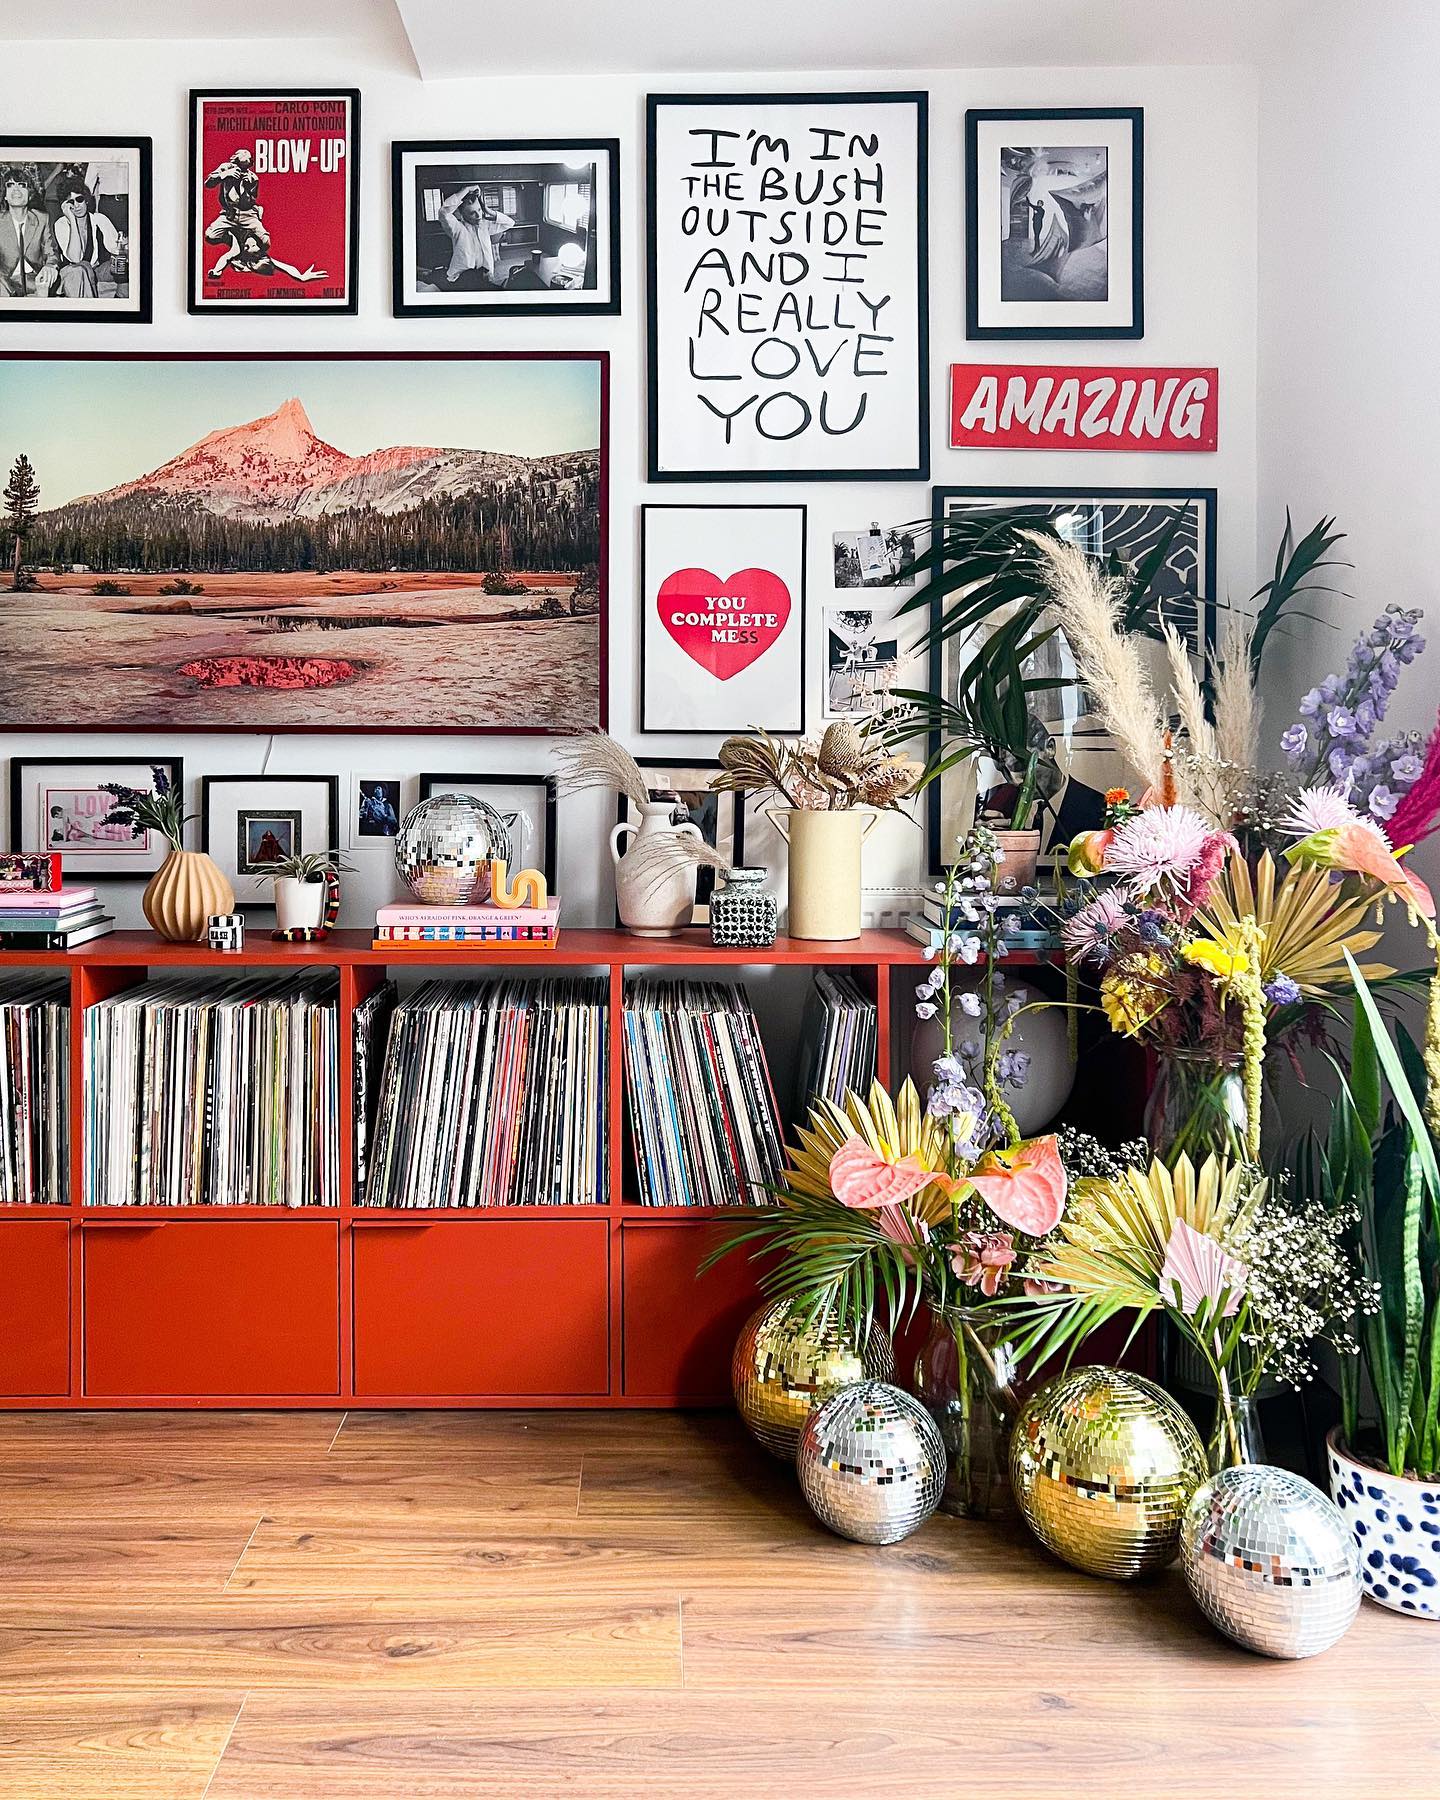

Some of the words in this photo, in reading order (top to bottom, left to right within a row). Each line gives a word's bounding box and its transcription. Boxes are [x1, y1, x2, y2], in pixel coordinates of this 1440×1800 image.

[217, 117, 289, 131] MICHELANGELO
[292, 116, 346, 131] ANTONIONI
[275, 102, 309, 113] CARLO
[313, 102, 346, 113] PONTI
[255, 138, 346, 173] BLOW-UP
[689, 129, 789, 166] I'M
[808, 128, 879, 160] IN
[680, 172, 744, 201] THE
[760, 163, 883, 205] BUSH
[681, 205, 888, 245] OUTSIDE
[684, 248, 809, 293] AND
[823, 251, 868, 283] I
[698, 288, 891, 338] REALLY
[689, 333, 894, 380] LOVE
[697, 390, 867, 444] YOU
[960, 376, 1209, 439] AMAZING
[671, 612, 779, 628] COMPLETE
[705, 597, 747, 611] YOU
[711, 629, 759, 644] MESS
[74, 795, 118, 817] LOV
